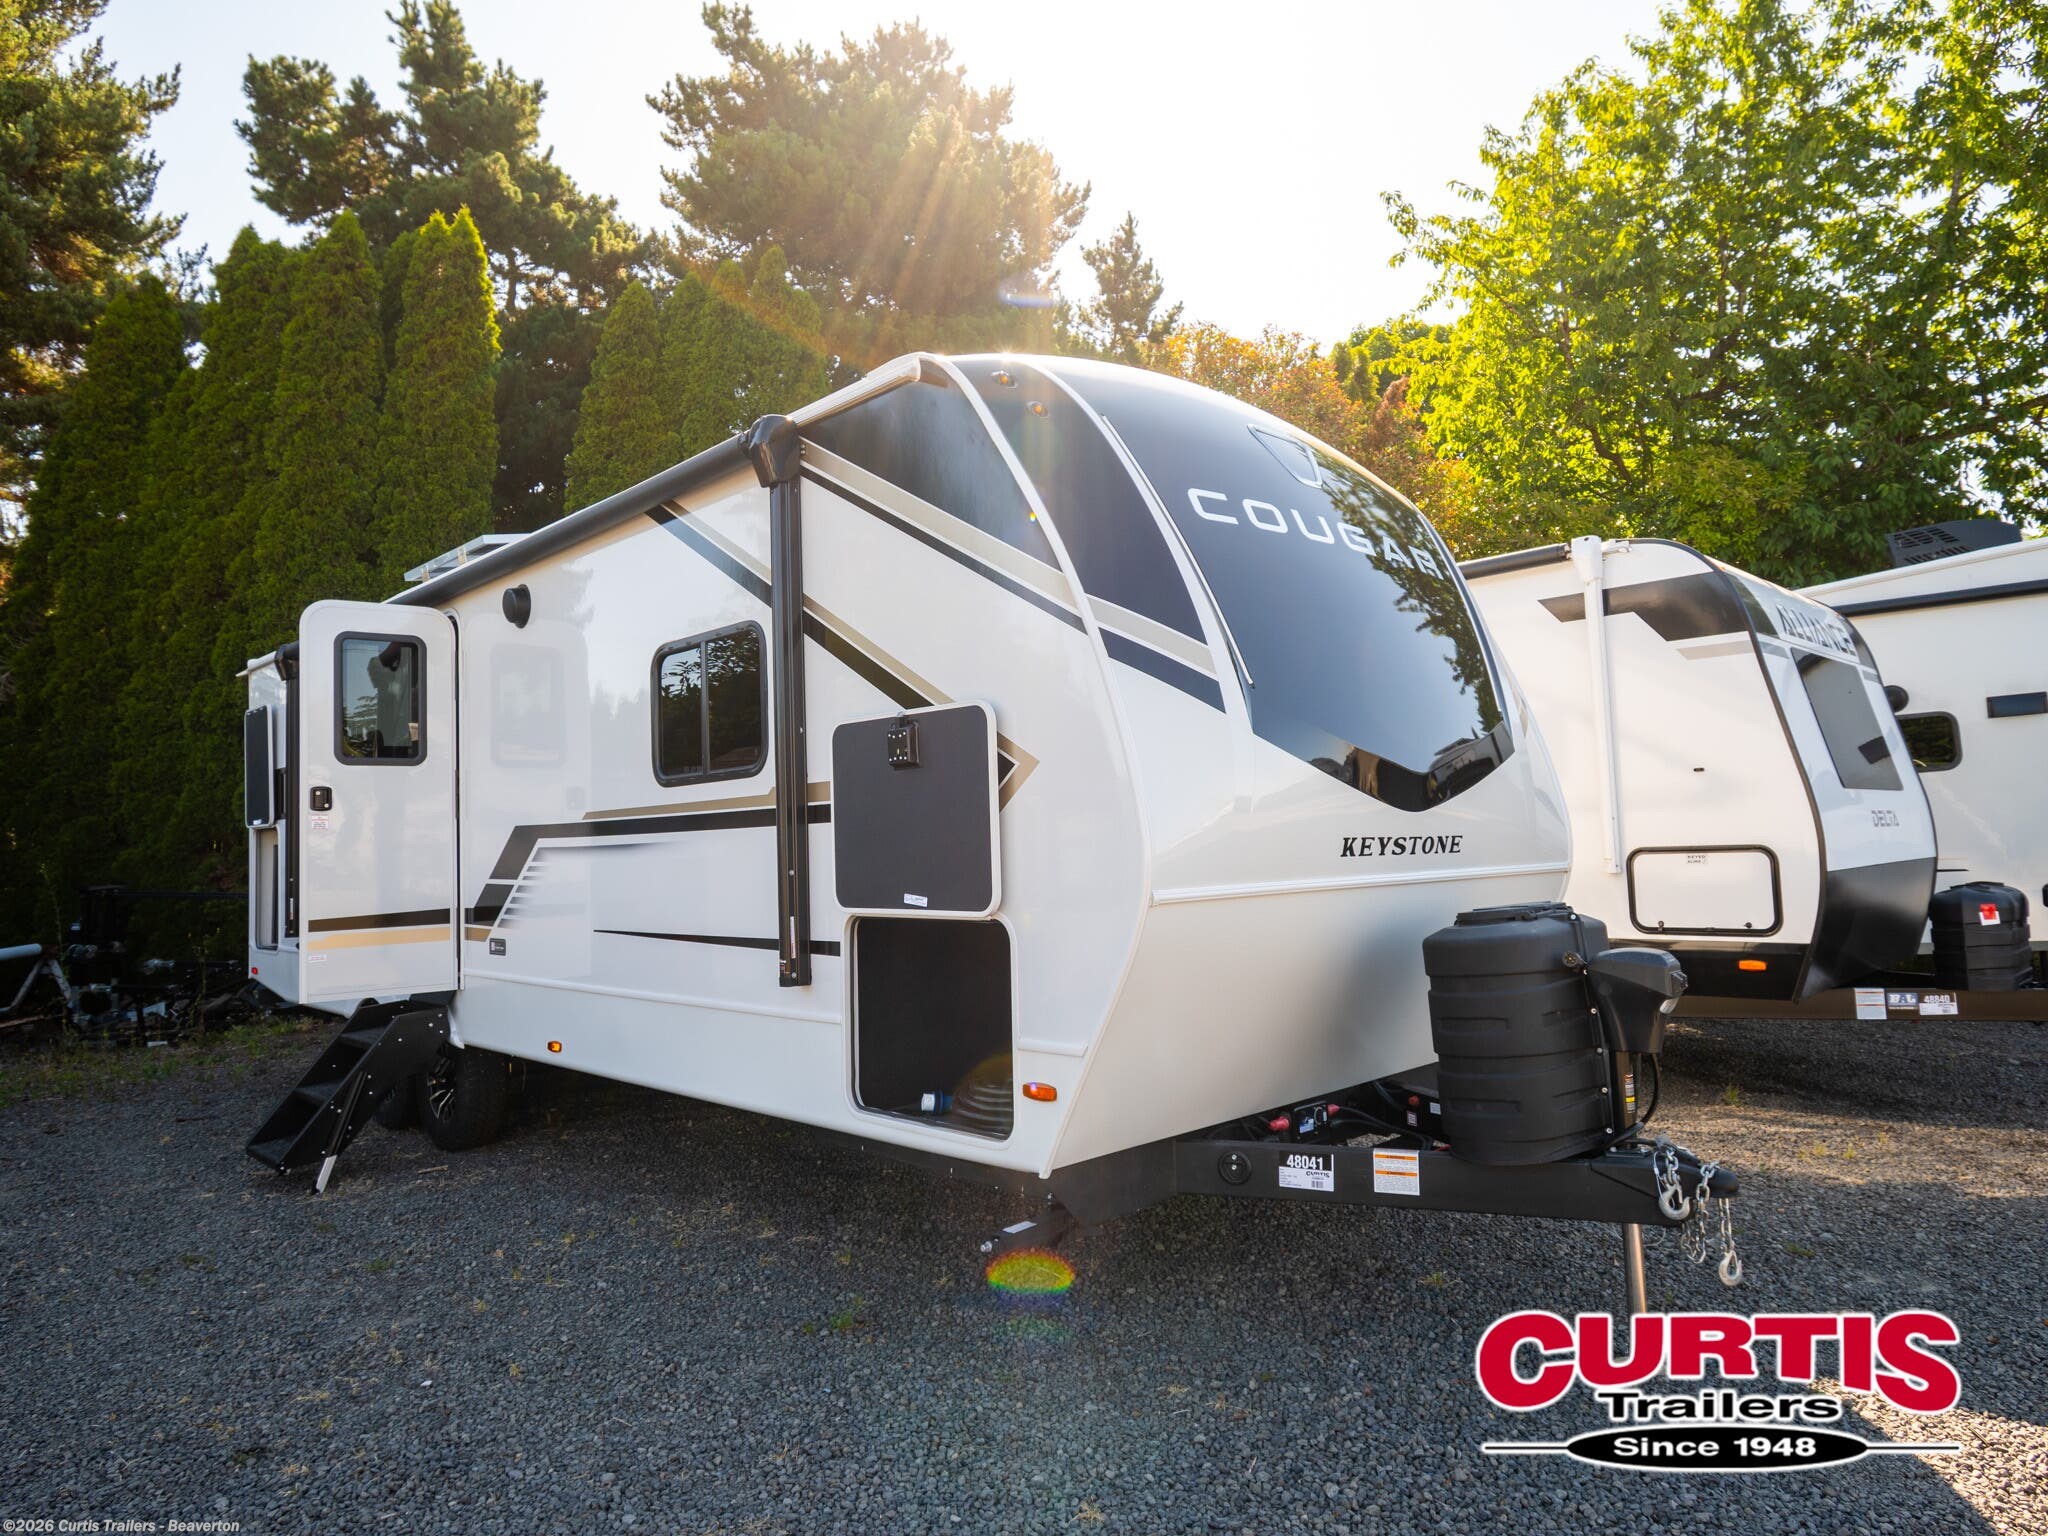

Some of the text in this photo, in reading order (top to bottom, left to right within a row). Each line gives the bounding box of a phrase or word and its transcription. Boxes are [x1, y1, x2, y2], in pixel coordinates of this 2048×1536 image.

[1187, 487, 1445, 581] COUGAR
[1871, 809, 1900, 828] DELTA
[1340, 835, 1463, 858] KEYSTONE
[1286, 1154, 1323, 1170] 48041
